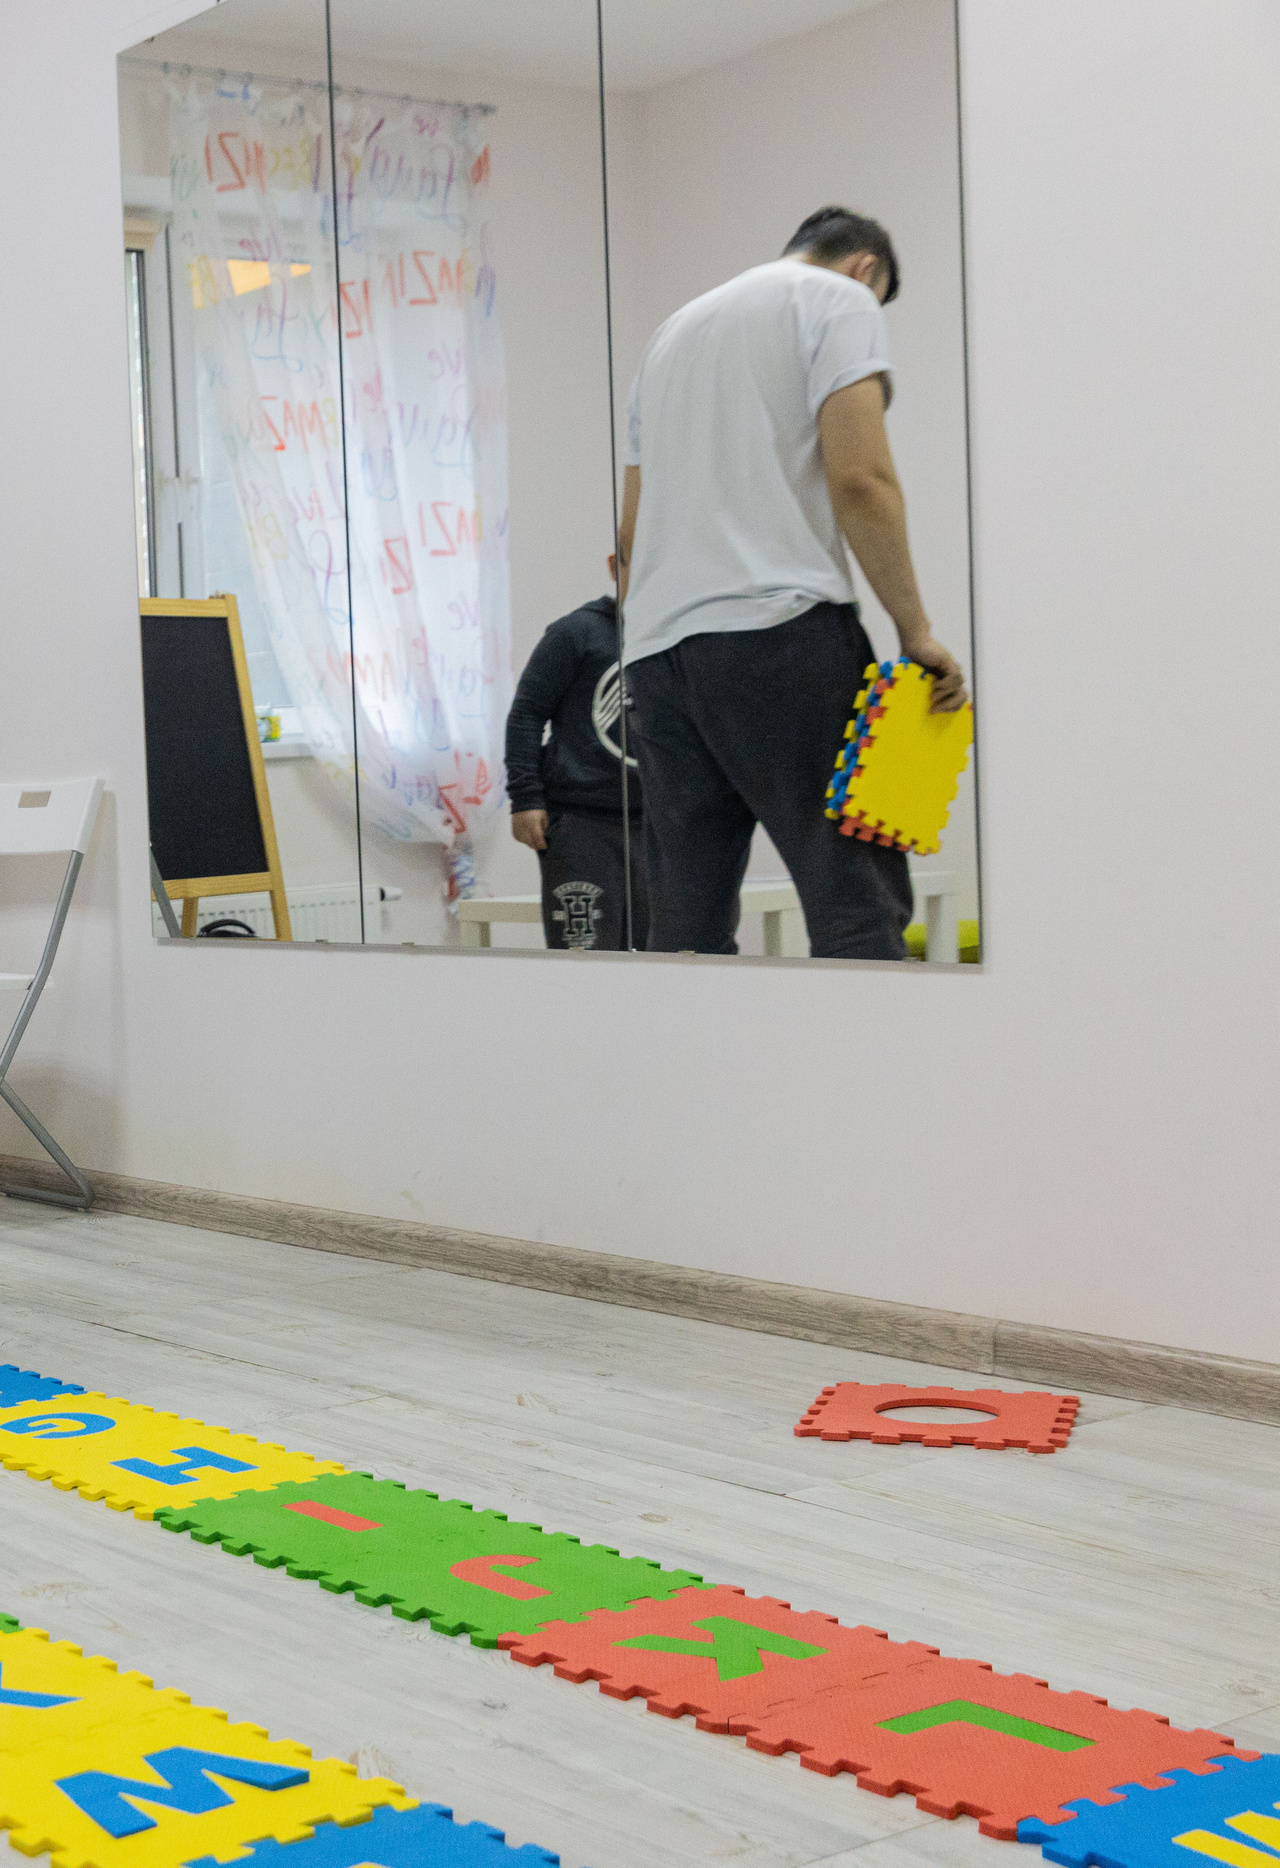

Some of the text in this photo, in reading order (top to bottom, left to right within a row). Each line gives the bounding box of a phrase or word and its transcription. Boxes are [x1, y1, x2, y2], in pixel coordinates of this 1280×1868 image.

[110, 1446, 260, 1487] H
[611, 1615, 830, 1682] K
[875, 1699, 1097, 1753] L
